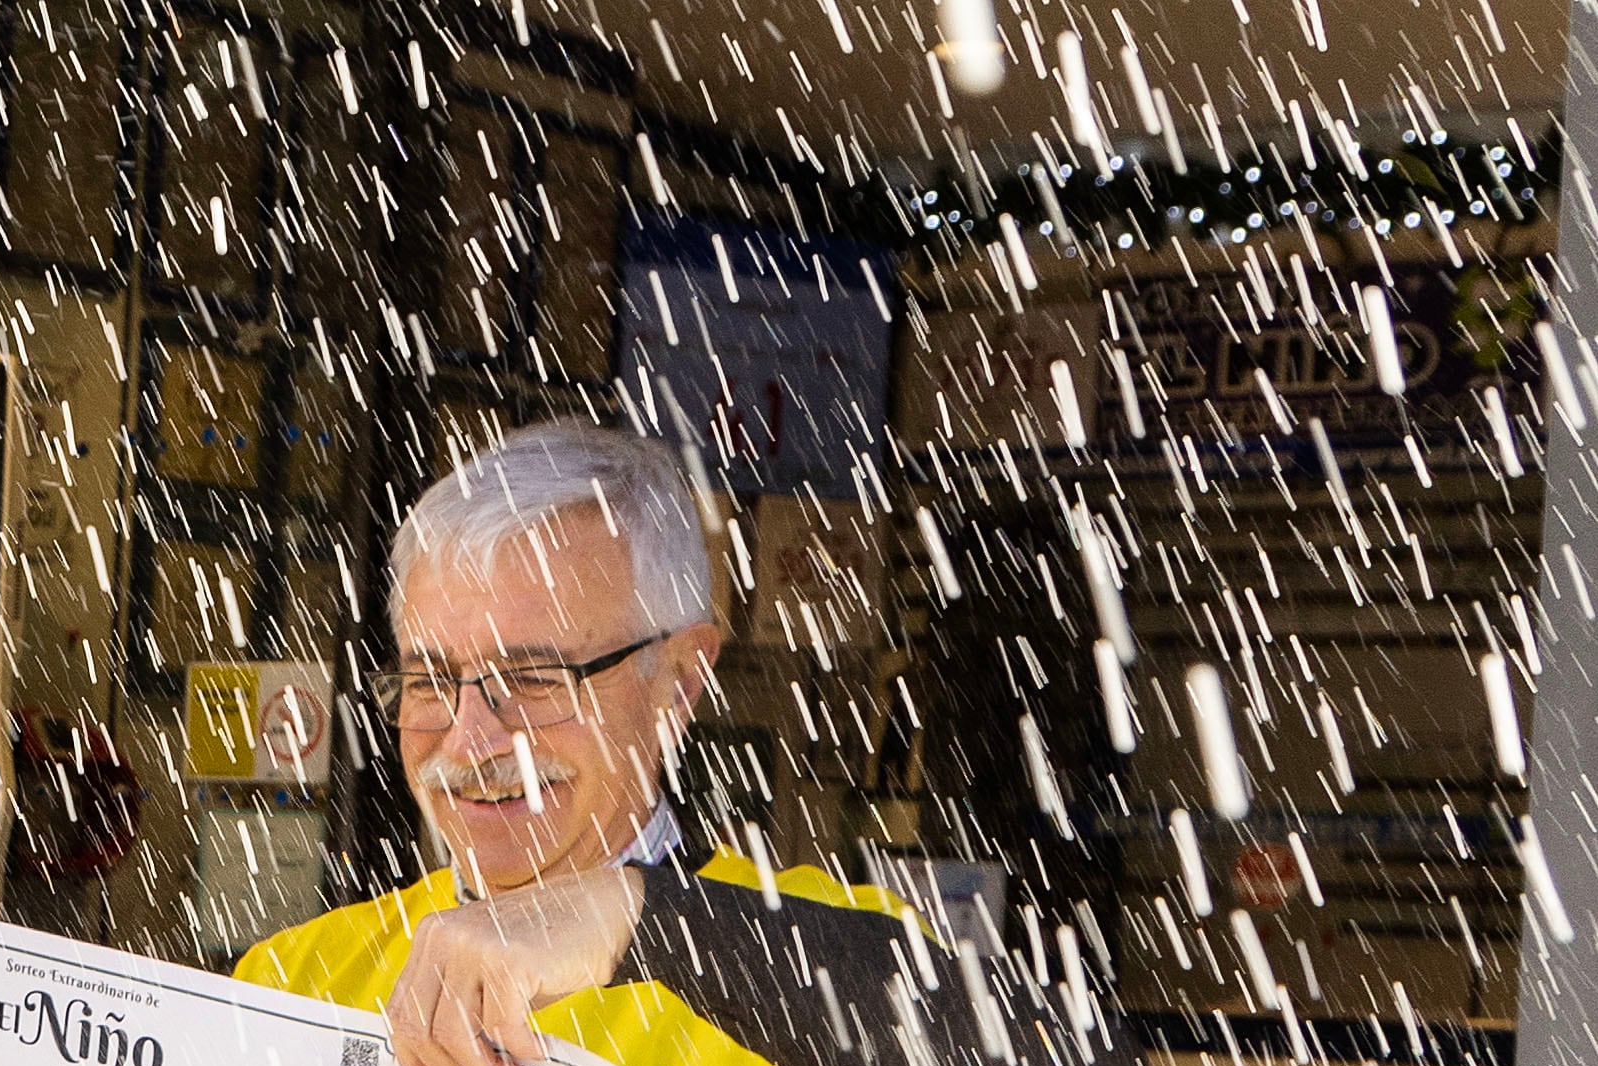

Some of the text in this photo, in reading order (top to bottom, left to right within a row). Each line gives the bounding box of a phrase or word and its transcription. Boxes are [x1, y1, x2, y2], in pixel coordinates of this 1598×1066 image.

[5, 958, 160, 1009] Sorteo Extraordinario de
